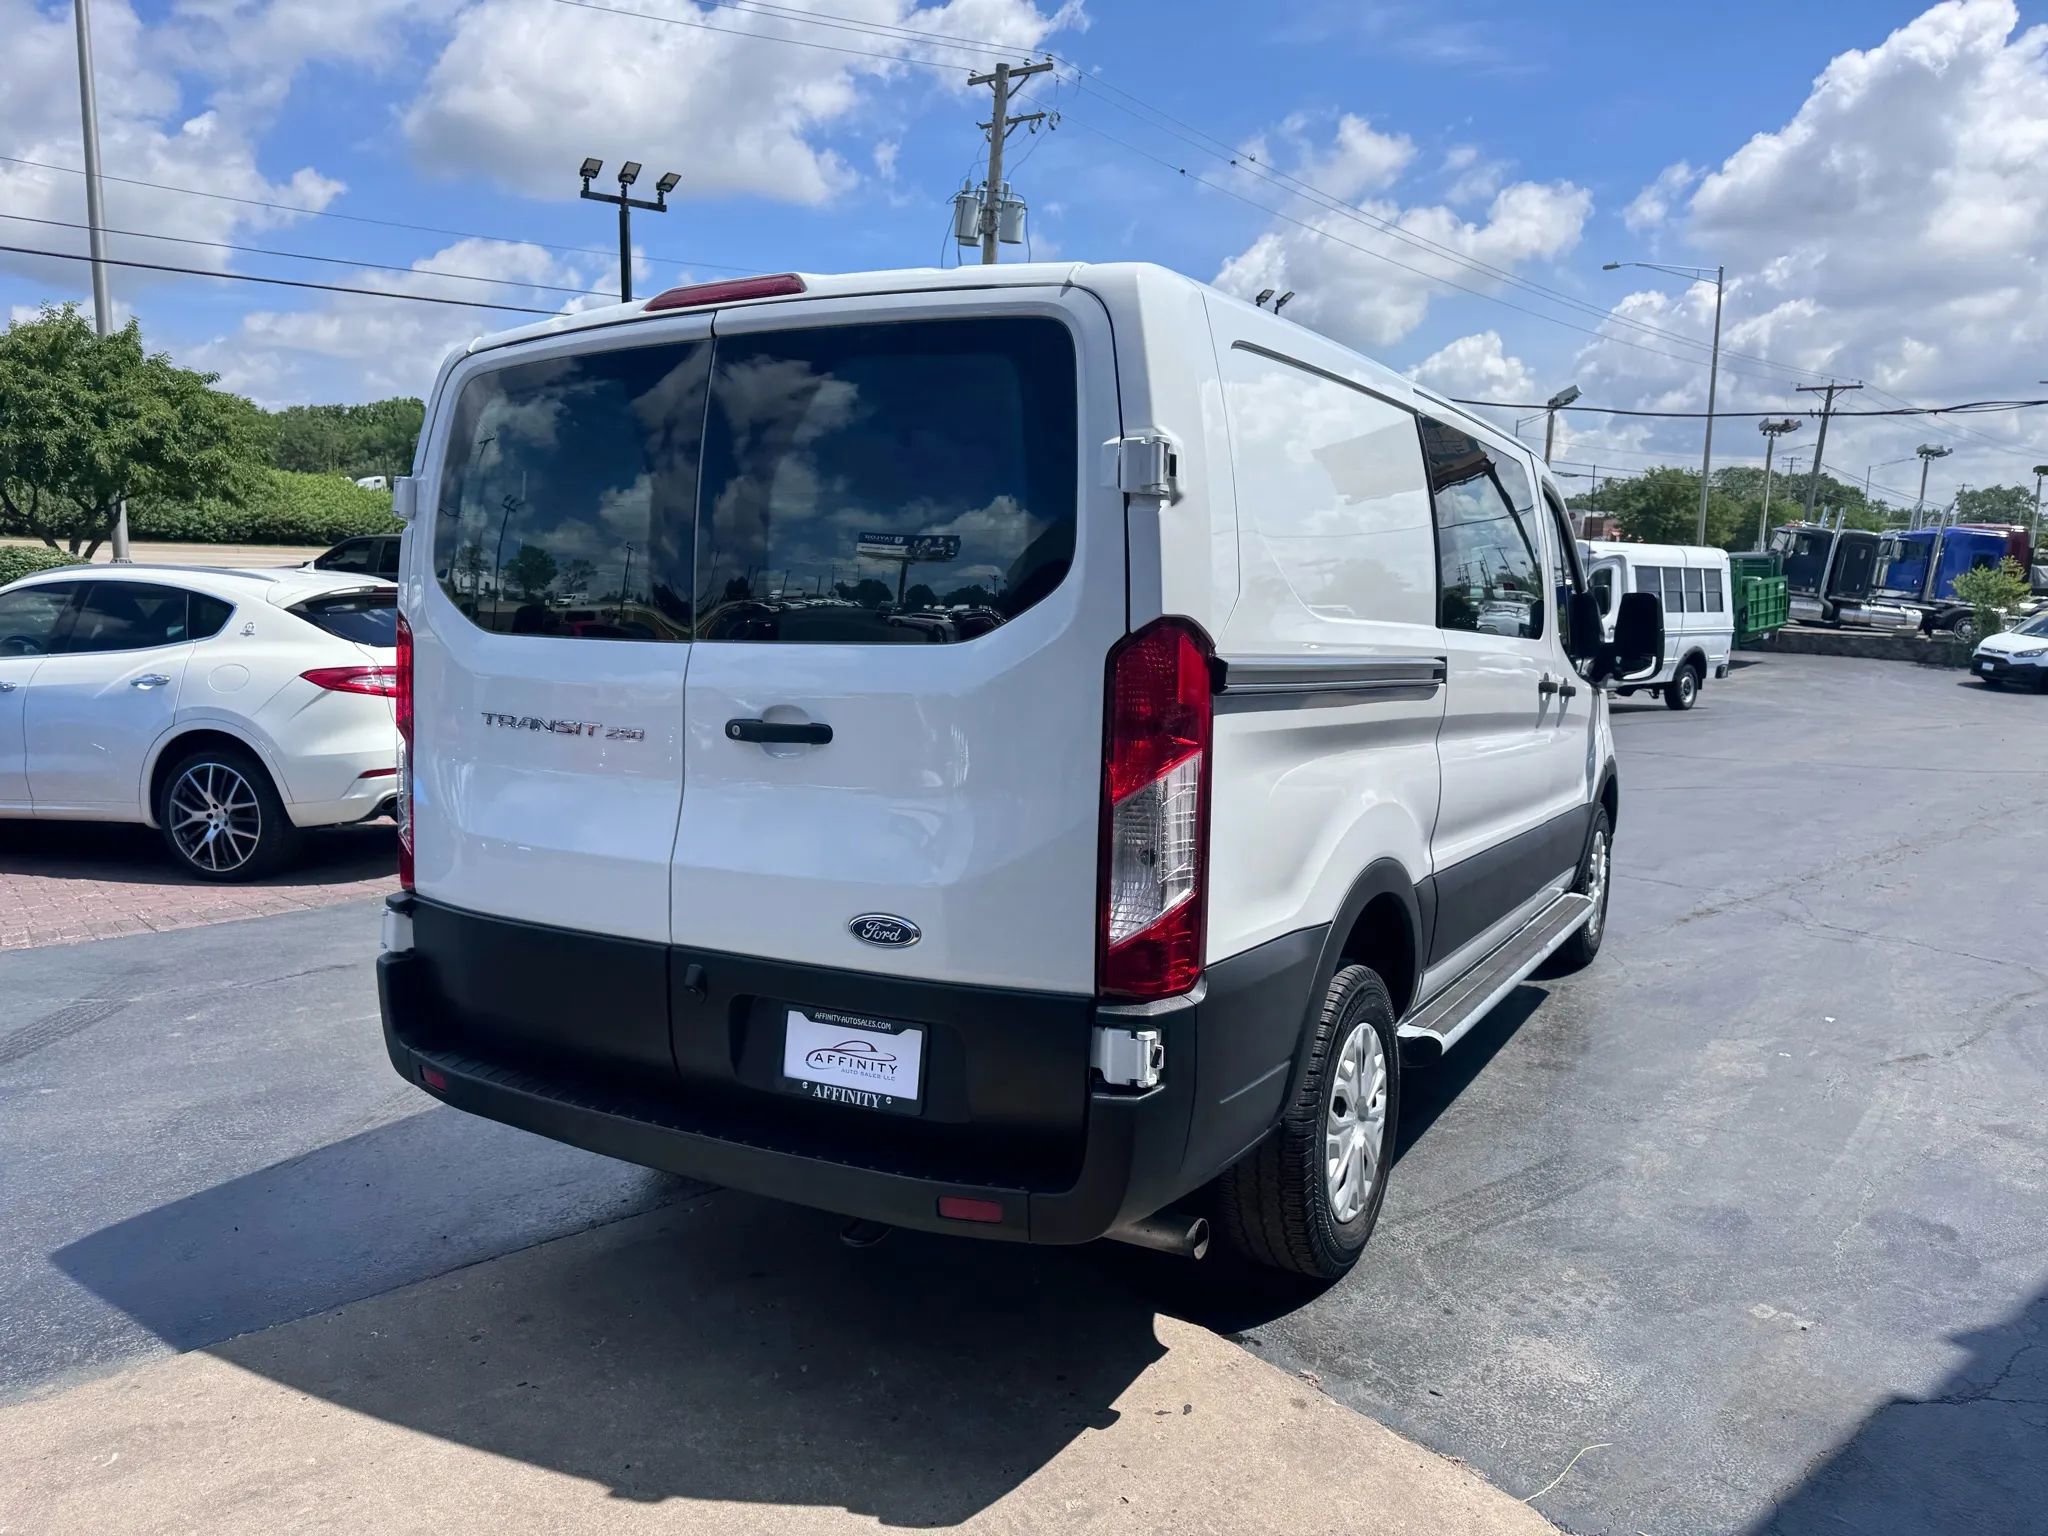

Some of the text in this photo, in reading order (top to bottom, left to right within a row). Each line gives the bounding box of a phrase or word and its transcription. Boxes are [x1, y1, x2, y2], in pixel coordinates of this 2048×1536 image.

[481, 712, 603, 737] TRANSIT
[862, 921, 901, 941] Ford
[814, 1012, 892, 1031] AFFINITY-AUTOSALES.COM
[814, 1052, 898, 1075] AFFINITY
[841, 1068, 858, 1076] AUTO
[812, 1084, 882, 1109] AFFINITY
